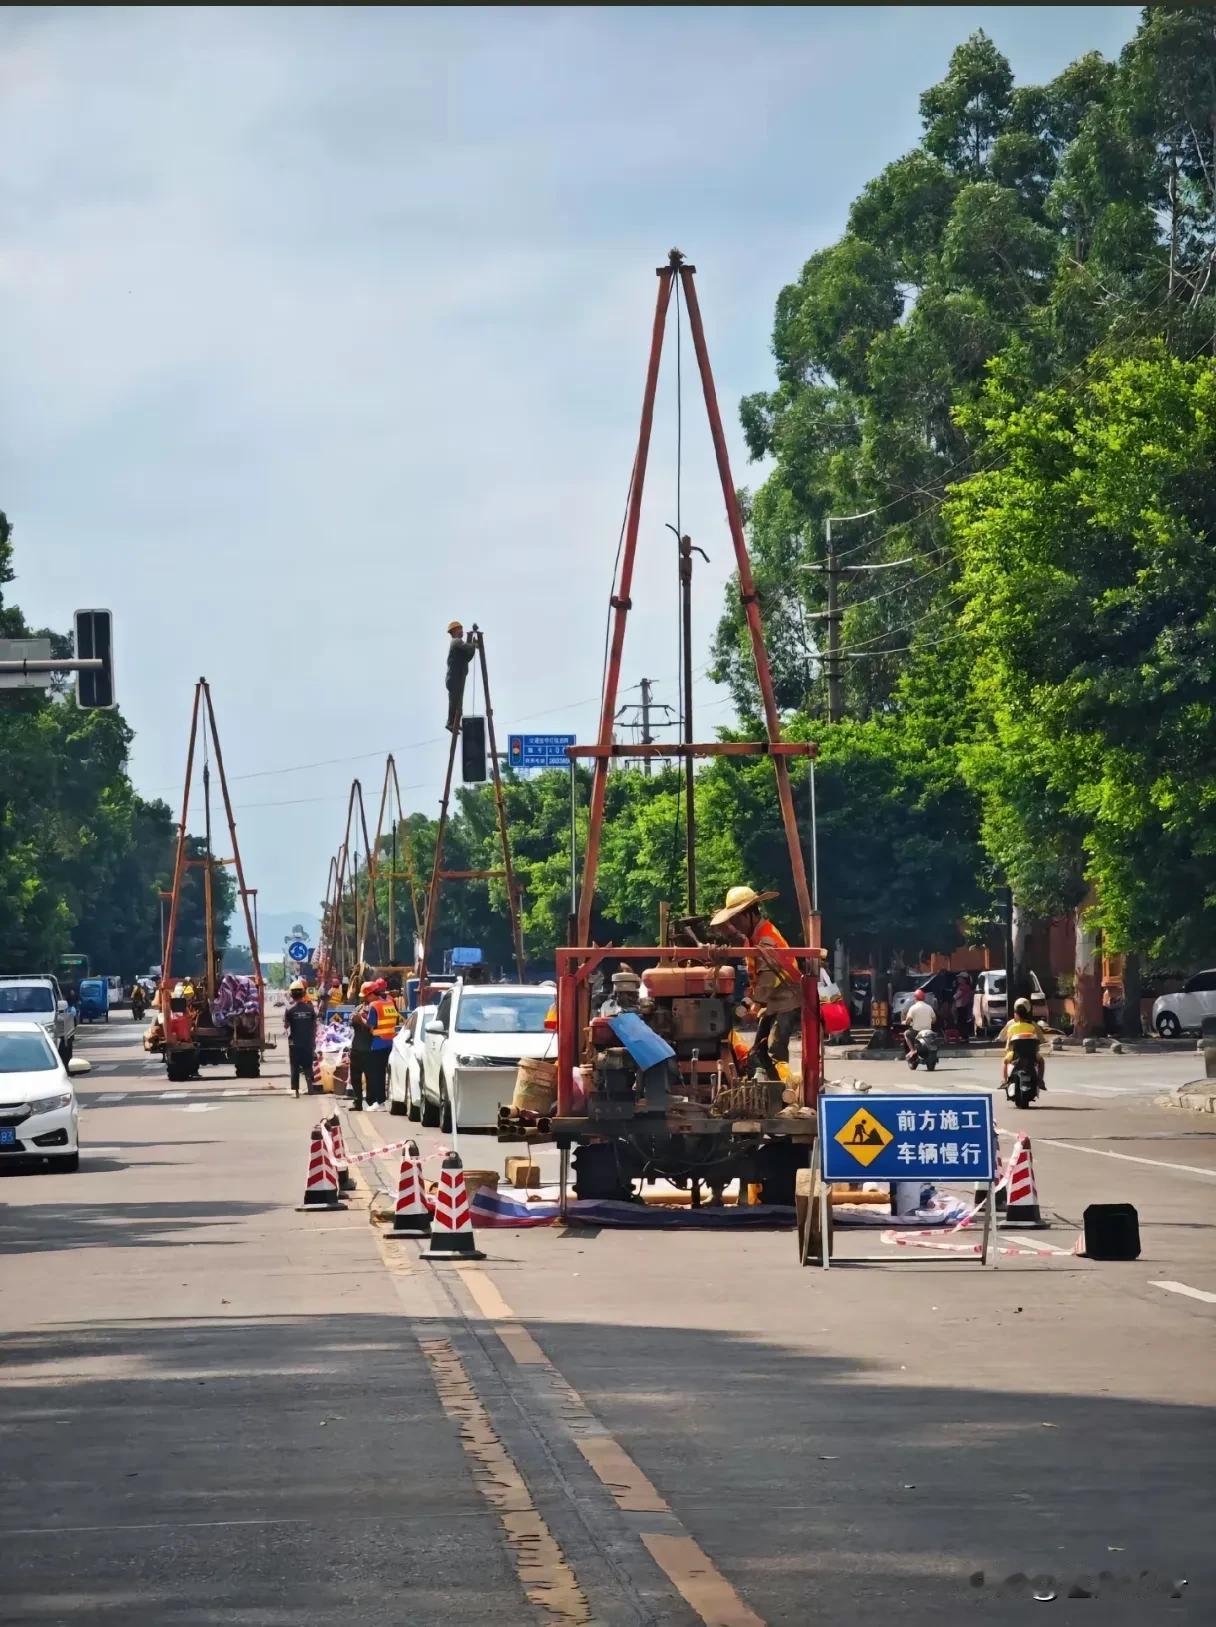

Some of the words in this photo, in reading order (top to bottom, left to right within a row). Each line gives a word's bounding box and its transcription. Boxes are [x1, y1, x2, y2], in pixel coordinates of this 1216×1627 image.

[896, 1109, 982, 1132] 前方施工
[896, 1142, 982, 1165] 车辆慢行
